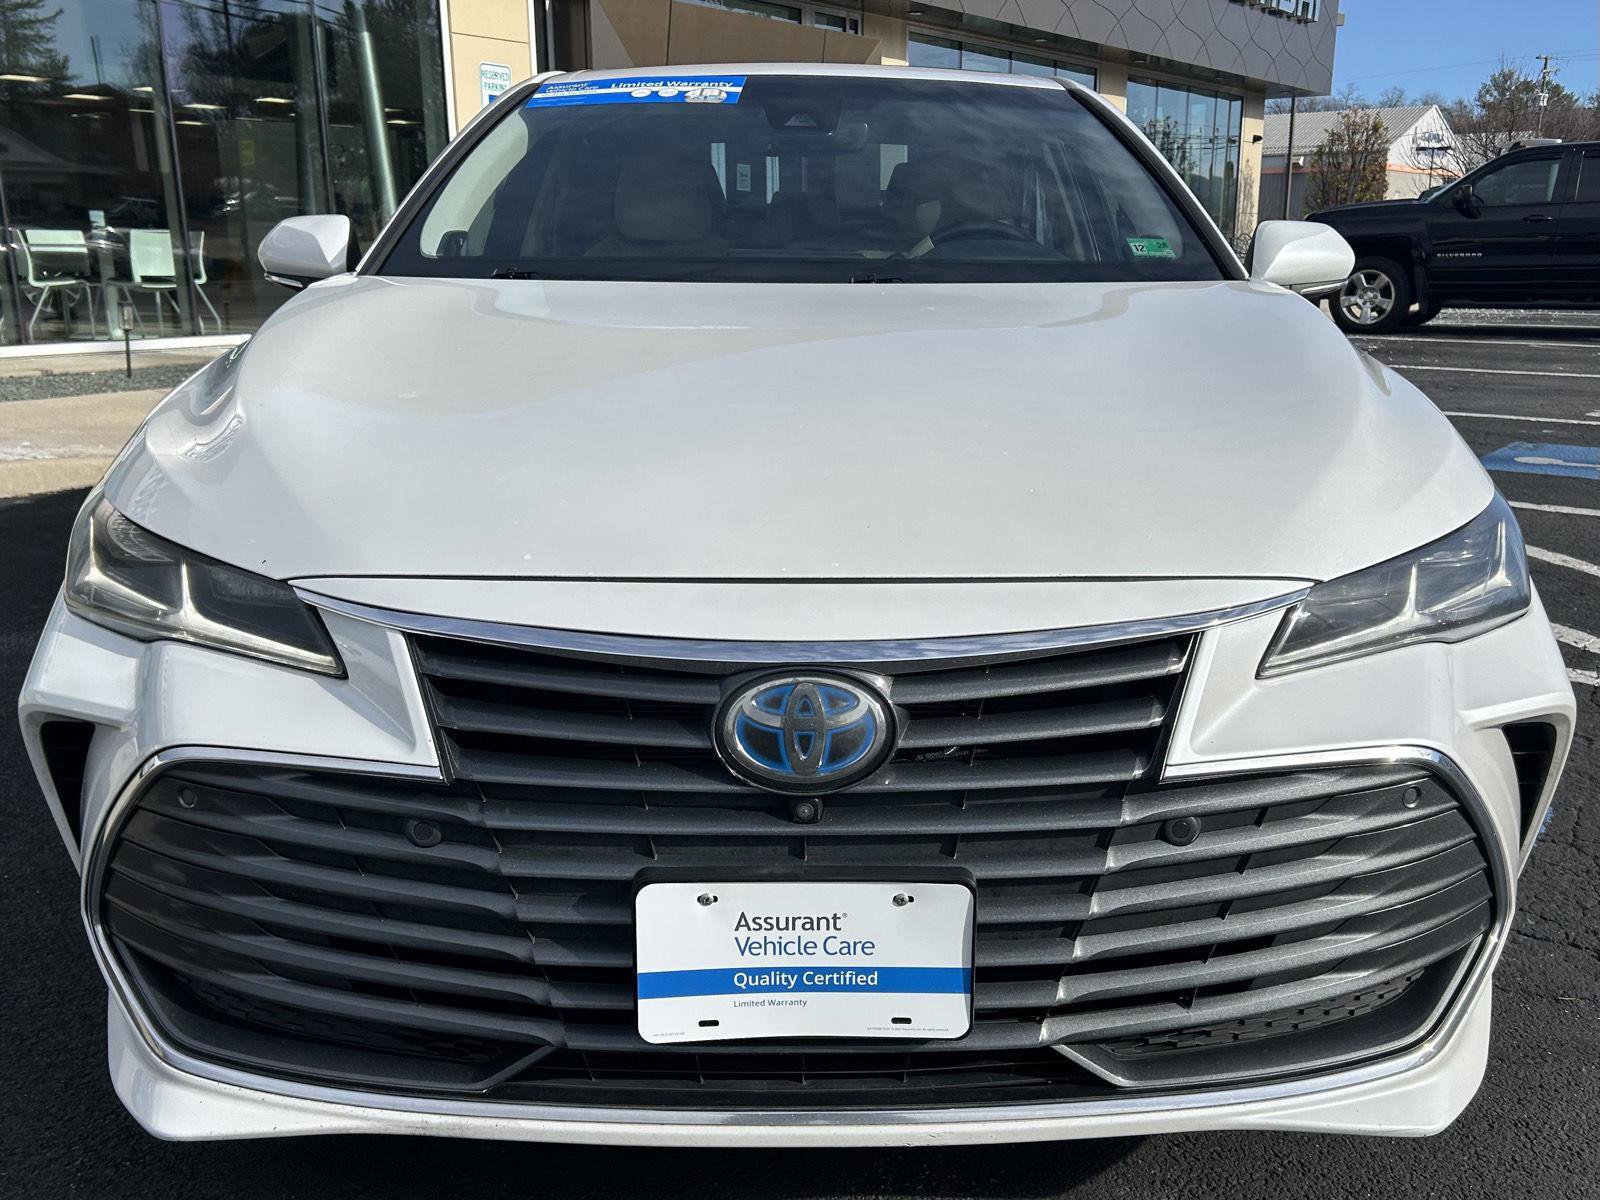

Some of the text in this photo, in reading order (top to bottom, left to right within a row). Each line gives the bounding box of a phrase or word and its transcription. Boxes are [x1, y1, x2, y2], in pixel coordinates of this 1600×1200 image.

[480, 69, 510, 81] RESERVED
[610, 80, 734, 89] Limited Warranty
[1133, 244, 1146, 252] 12
[734, 935, 876, 956] Vehicle Care
[733, 970, 878, 989] Quality Certified
[733, 998, 808, 1008] Limited Warranty
